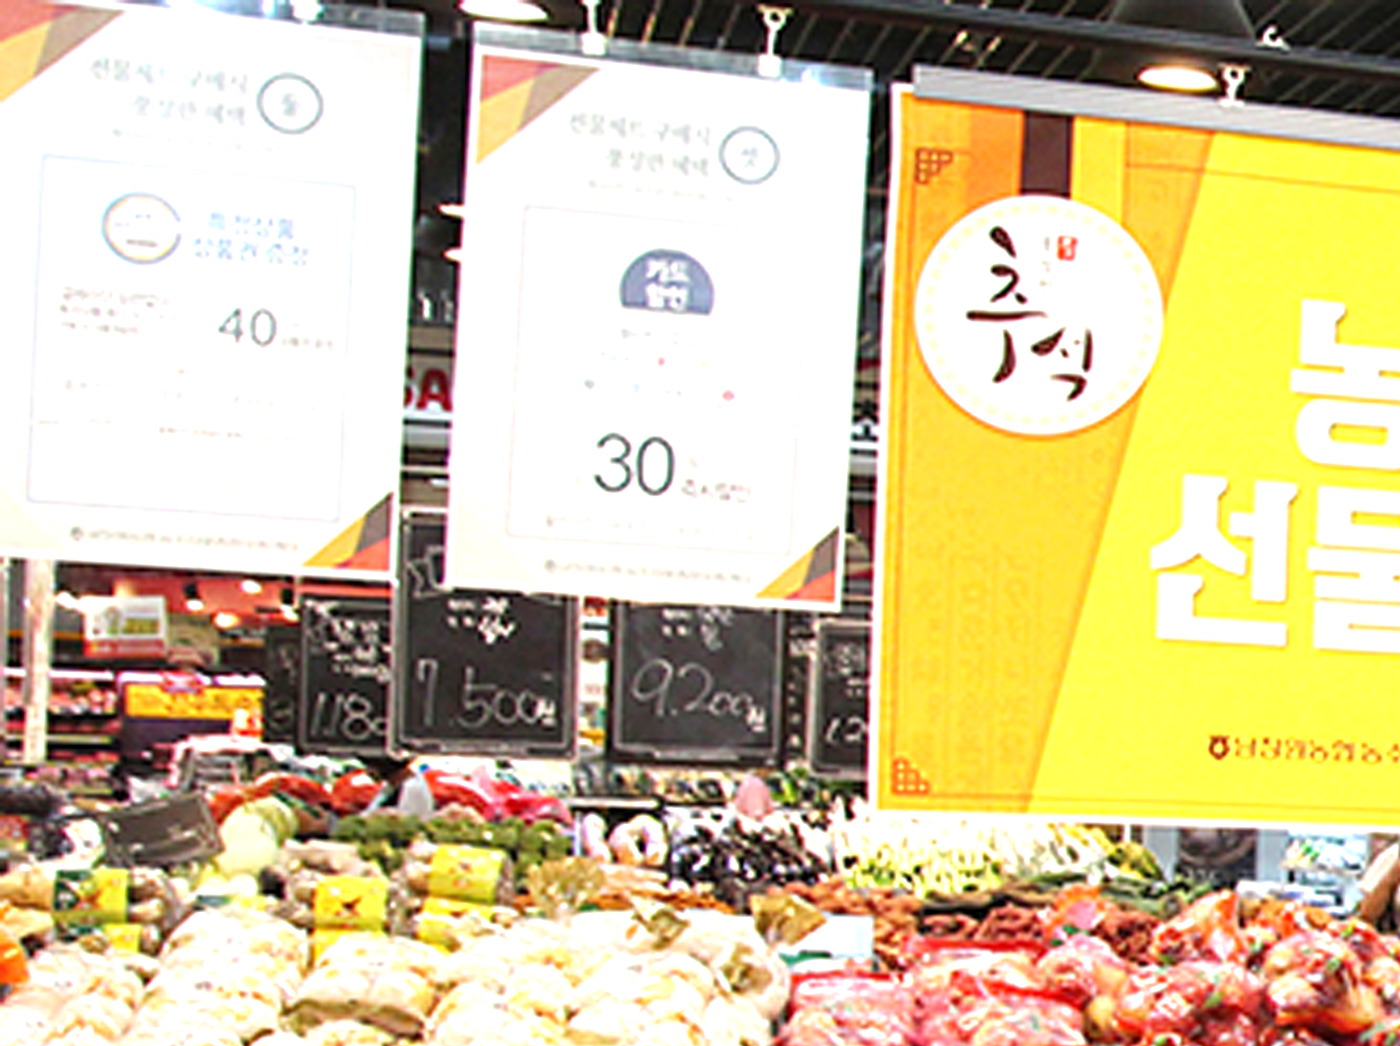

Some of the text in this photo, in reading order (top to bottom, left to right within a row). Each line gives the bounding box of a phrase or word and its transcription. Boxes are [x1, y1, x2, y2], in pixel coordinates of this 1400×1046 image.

[216, 306, 278, 349] 40
[965, 224, 1095, 403] 추석
[593, 431, 677, 497] 30
